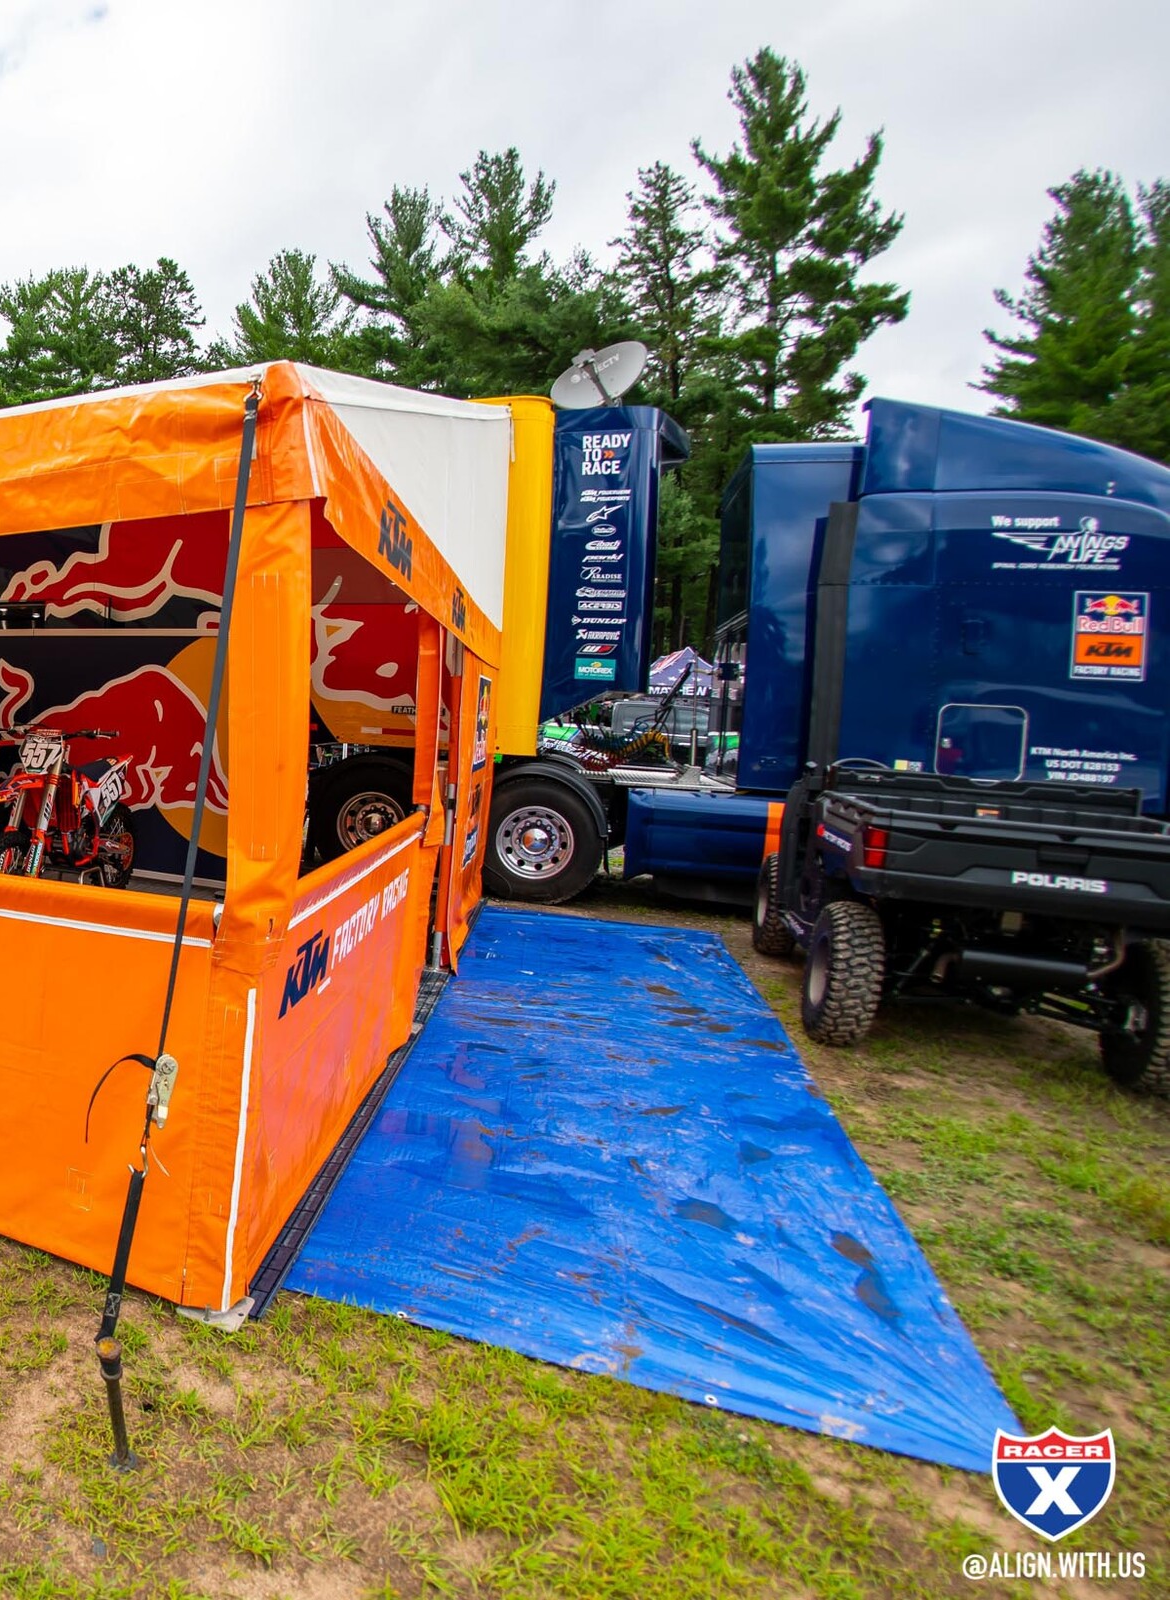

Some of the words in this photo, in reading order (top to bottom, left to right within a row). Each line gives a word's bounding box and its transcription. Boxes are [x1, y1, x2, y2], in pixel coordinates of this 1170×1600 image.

[582, 433, 631, 449] READY
[583, 448, 602, 462] TO
[581, 460, 621, 476] RACE
[991, 515, 1012, 527] We
[1014, 516, 1060, 529] support
[377, 500, 413, 582] KTM
[581, 617, 628, 625] DUNLOP
[1077, 615, 1110, 633] Red
[1110, 616, 1145, 634] Bull
[1084, 641, 1134, 658] KTM
[578, 666, 614, 675] MOTOREX
[21, 742, 62, 769] 557
[1081, 749, 1118, 760] America
[1044, 759, 1059, 769] US
[1060, 760, 1082, 770] DOT
[101, 773, 123, 807] 557
[1011, 870, 1109, 894] POLARIS
[277, 929, 331, 1021] KTM
[331, 892, 380, 970] FACTORY
